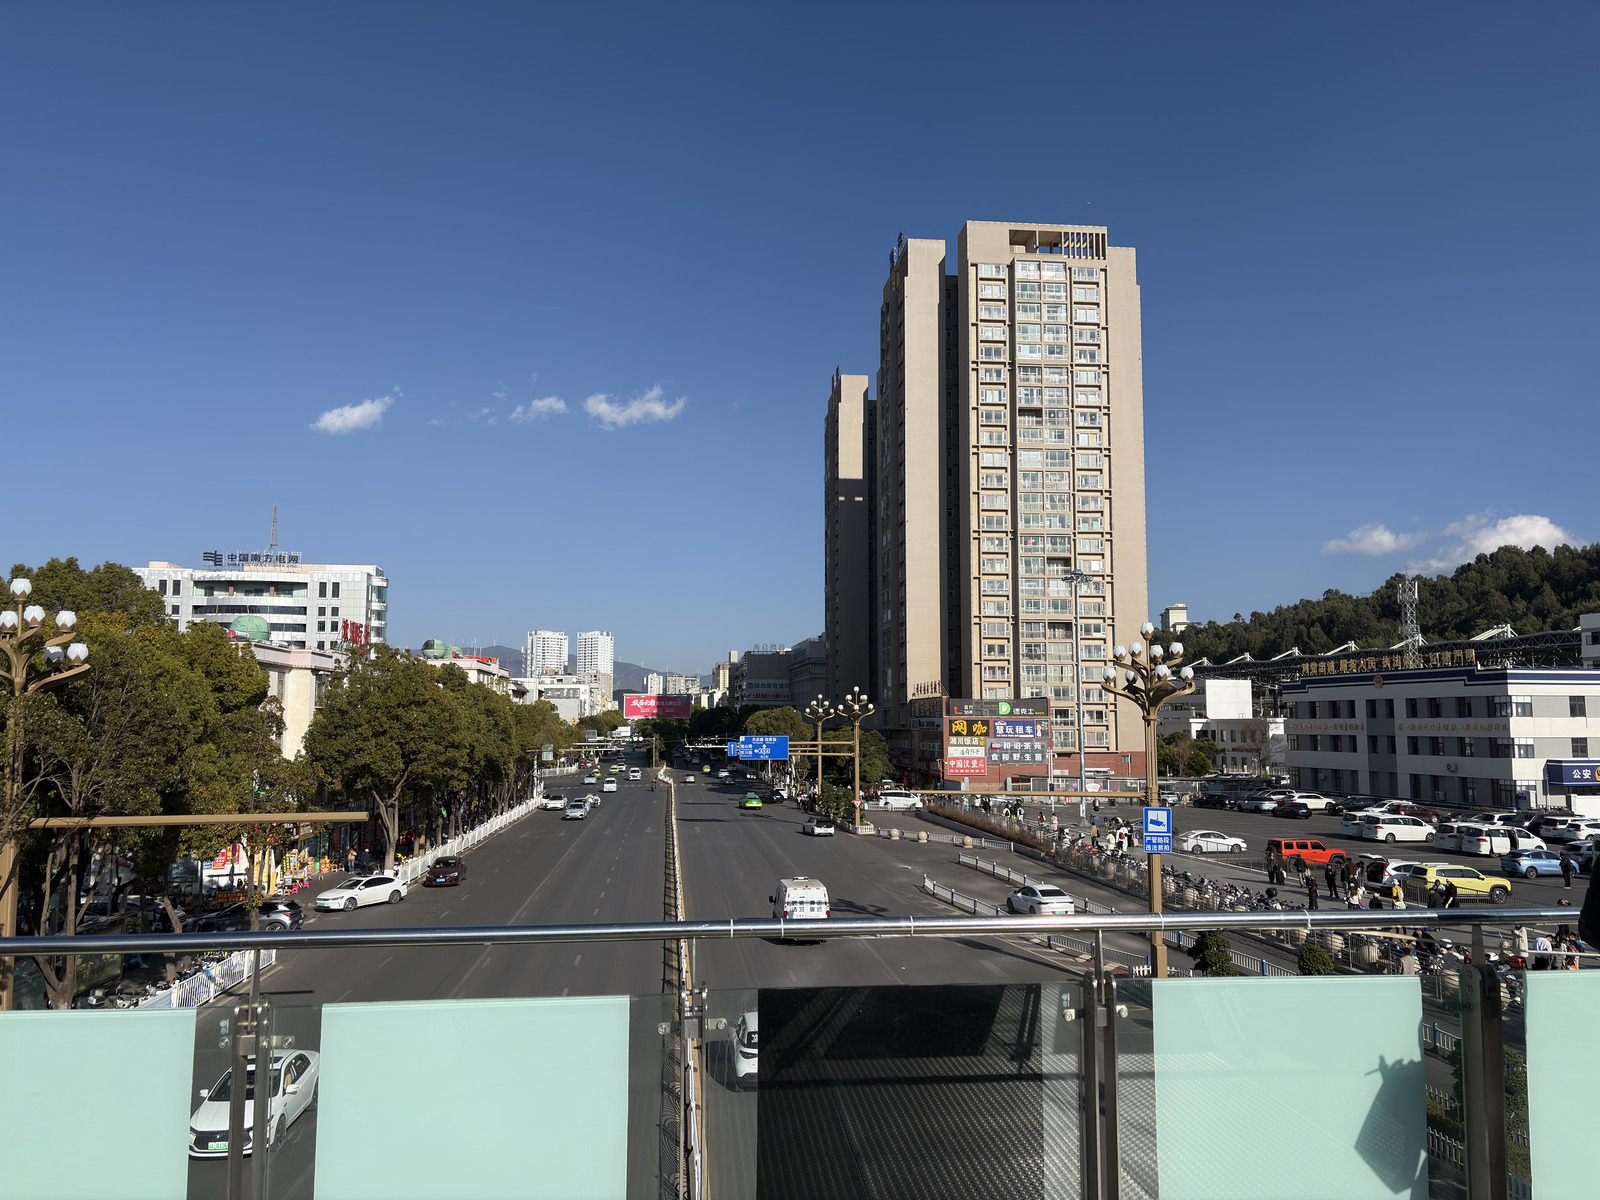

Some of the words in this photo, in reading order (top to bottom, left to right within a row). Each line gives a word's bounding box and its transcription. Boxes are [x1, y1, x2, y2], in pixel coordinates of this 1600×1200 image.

[227, 553, 299, 564] 中国南方电网
[1339, 657, 1377, 673] 服务人民
[952, 719, 988, 736] 网咖
[949, 759, 979, 768] 中国汉堡
[1572, 768, 1591, 779] 公安
